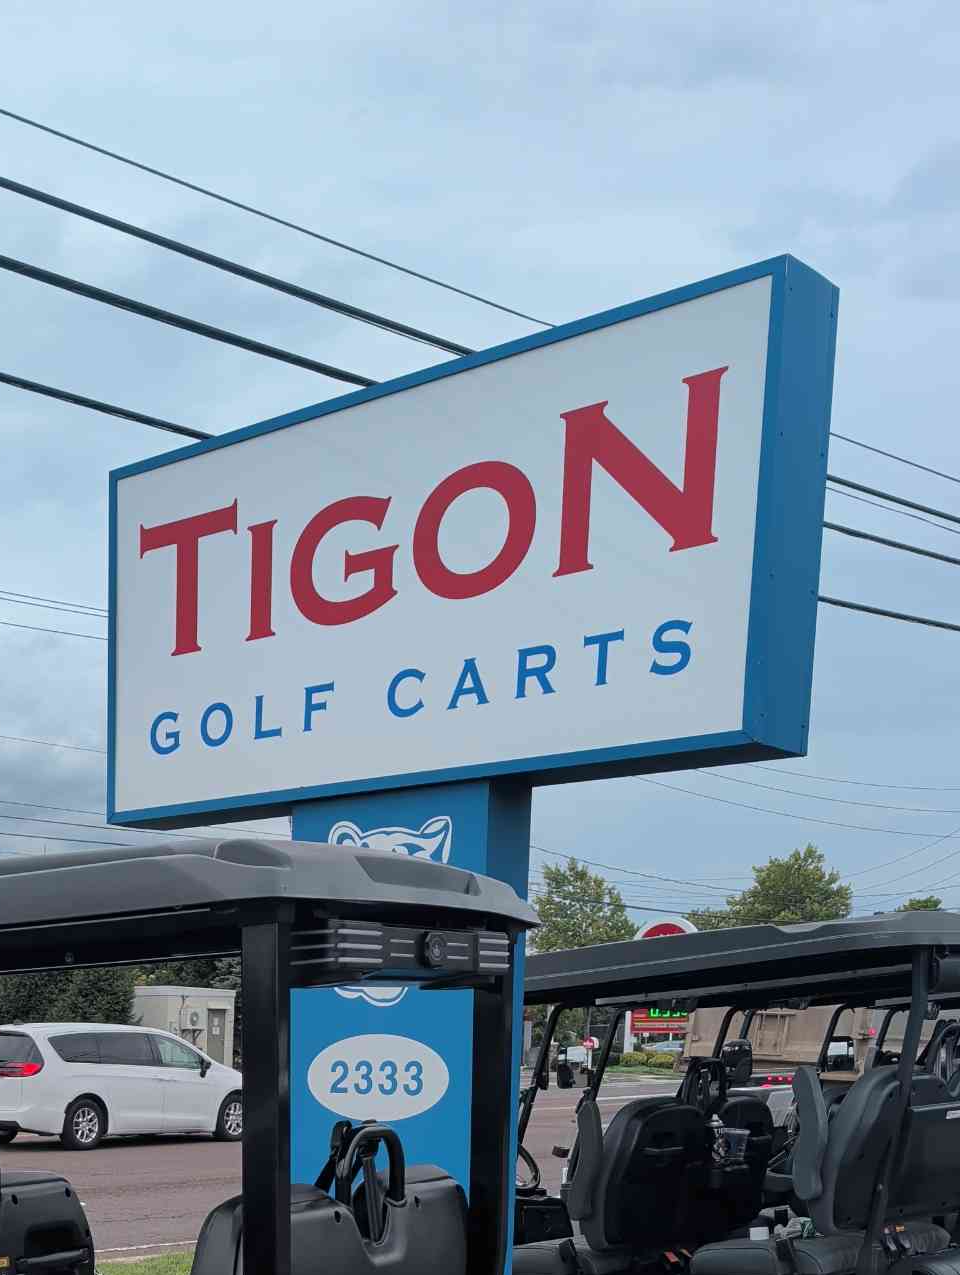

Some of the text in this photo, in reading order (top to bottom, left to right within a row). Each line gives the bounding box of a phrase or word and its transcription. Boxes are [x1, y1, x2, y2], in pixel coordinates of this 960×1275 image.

[140, 366, 729, 656] TIGON
[150, 619, 694, 755] GOLF CARTS
[330, 1060, 424, 1096] 2333
